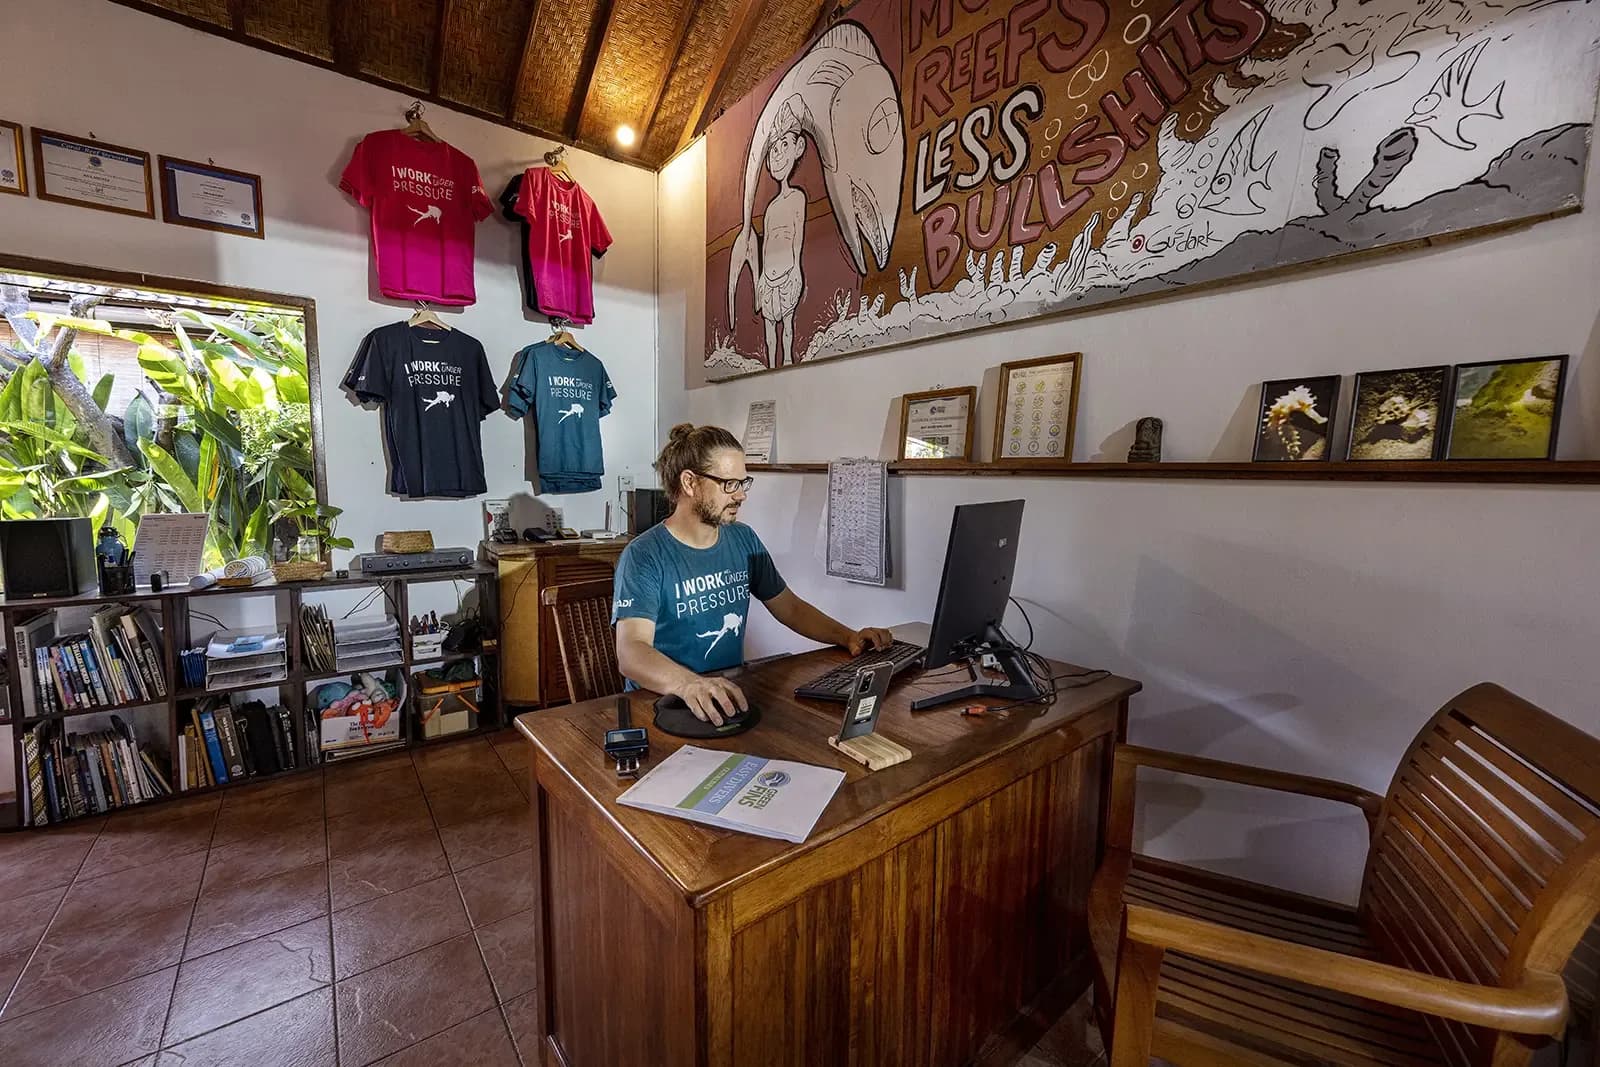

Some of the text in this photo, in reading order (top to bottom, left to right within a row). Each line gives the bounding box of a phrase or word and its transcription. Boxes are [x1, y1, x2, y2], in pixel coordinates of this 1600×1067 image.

[911, 0, 1110, 130] REEFS
[914, 82, 1045, 213] LESS
[391, 165, 396, 178] I
[397, 167, 432, 185] WORK
[393, 180, 454, 201] PRESSURE
[404, 363, 410, 374] I
[411, 360, 441, 373] WORK
[408, 373, 462, 388] PRESSURE
[553, 375, 576, 388] WORK
[674, 570, 749, 599] I WORK UNDER
[613, 598, 633, 608] ADI
[676, 583, 751, 619] PRESSURE
[738, 761, 759, 782] EASY
[709, 777, 741, 804] DIVERS
[738, 785, 769, 808] FINS
[752, 788, 778, 810] GREEN
